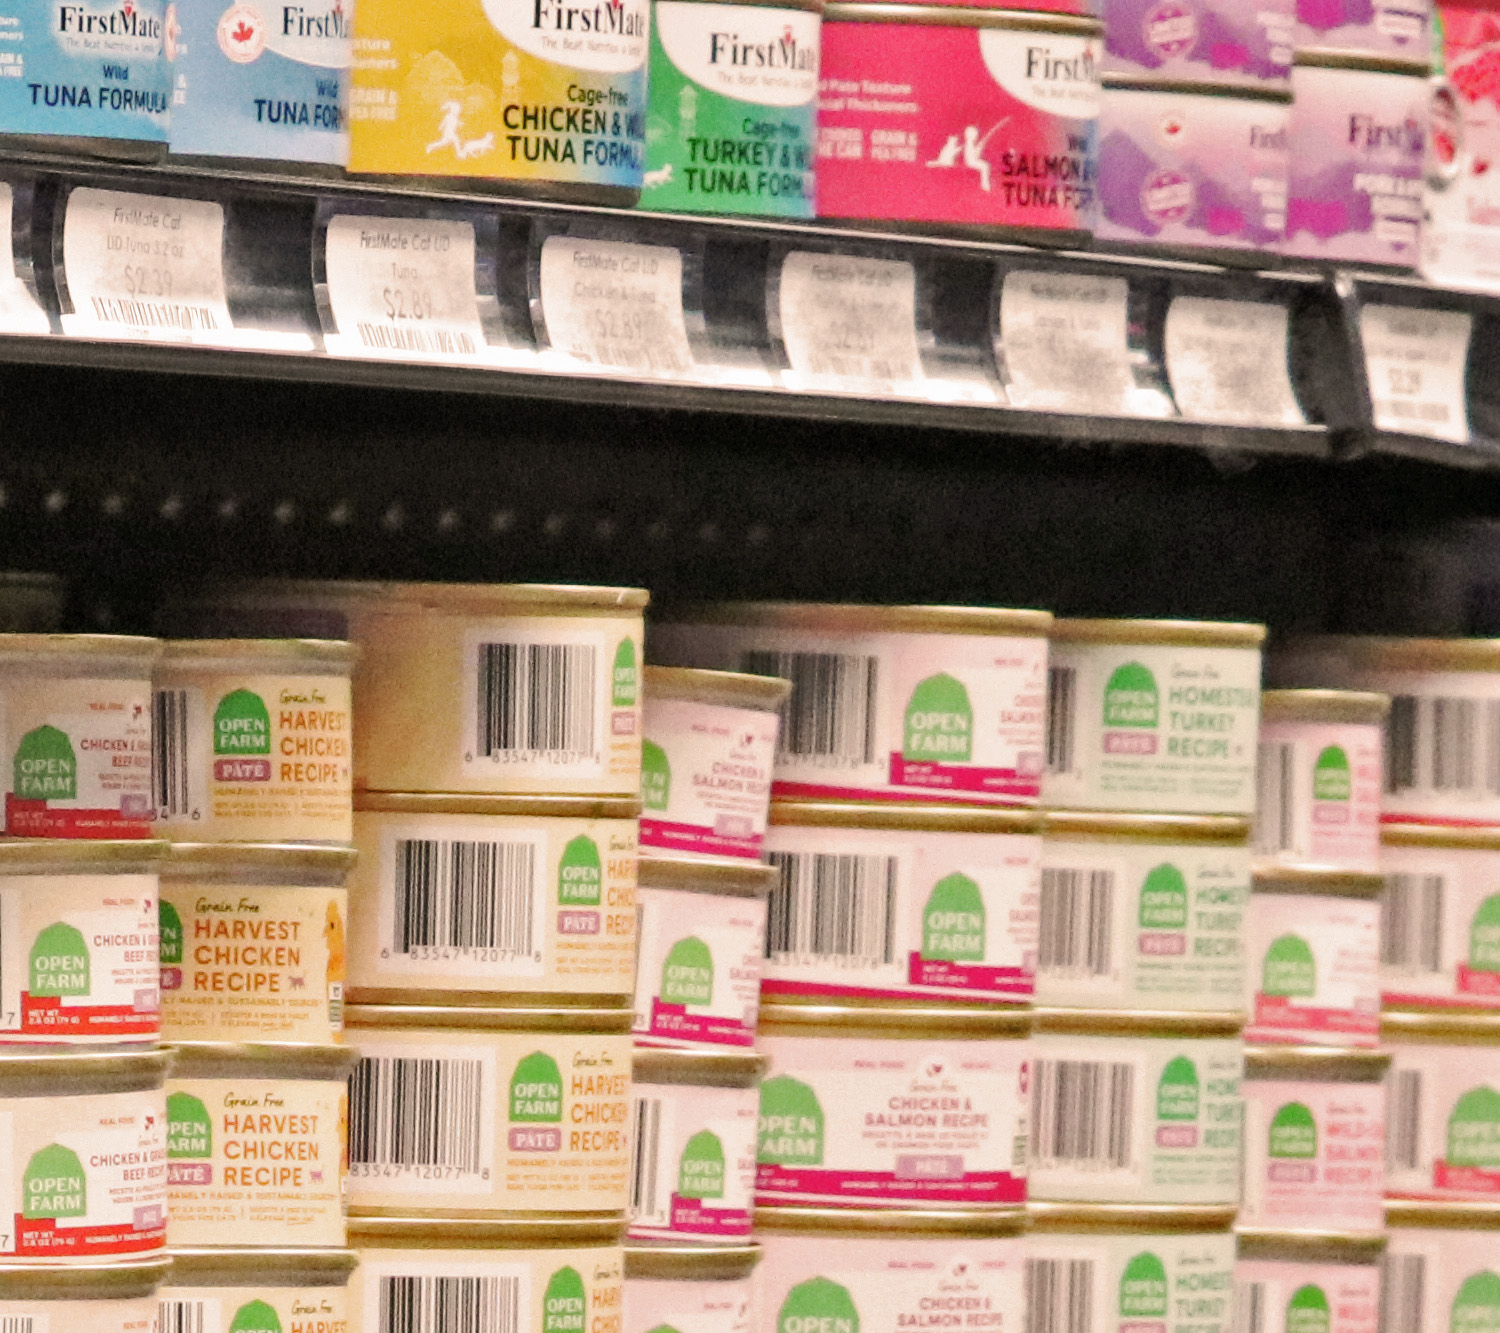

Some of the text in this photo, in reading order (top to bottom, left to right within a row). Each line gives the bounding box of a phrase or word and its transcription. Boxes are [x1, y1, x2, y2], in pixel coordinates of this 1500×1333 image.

[58, 6, 161, 39] FirstMate
[103, 65, 129, 81] Wild
[28, 84, 169, 114] TUNA FORMULA
[567, 84, 629, 106] Cage-free
[503, 104, 622, 135] CHICKEN &
[507, 135, 575, 163] TUNA
[687, 138, 777, 167] TURKEY
[685, 168, 749, 194] TUNA
[162, 213, 181, 230] Cat
[360, 232, 408, 249] FirstMate
[411, 233, 431, 250] Cat
[124, 265, 172, 296] $2.39
[391, 265, 417, 280] Tuna
[383, 289, 432, 321] $2.89
[219, 717, 265, 733] OPEN
[1168, 711, 1237, 731] TURKEY
[219, 733, 266, 748] FARM
[1168, 738, 1231, 756] RECIPE
[280, 763, 339, 782] RECIPE
[195, 897, 259, 914] Grain Free
[194, 919, 300, 940] HARVEST
[928, 912, 980, 929] OPEN
[928, 934, 982, 951] FARM
[35, 956, 85, 971] OPEN
[194, 946, 300, 966] CHICKEN
[410, 948, 518, 962] 83547 12077
[35, 974, 89, 990] FARM
[194, 972, 280, 992] RECIPE
[224, 1092, 284, 1107] Grain Free
[888, 1097, 956, 1111] CHICKEN
[224, 1115, 318, 1134] HARVEST
[864, 1112, 987, 1128] SALMON RECIPE
[223, 1141, 318, 1160] CHICKEN
[224, 1167, 302, 1187] RECIPE
